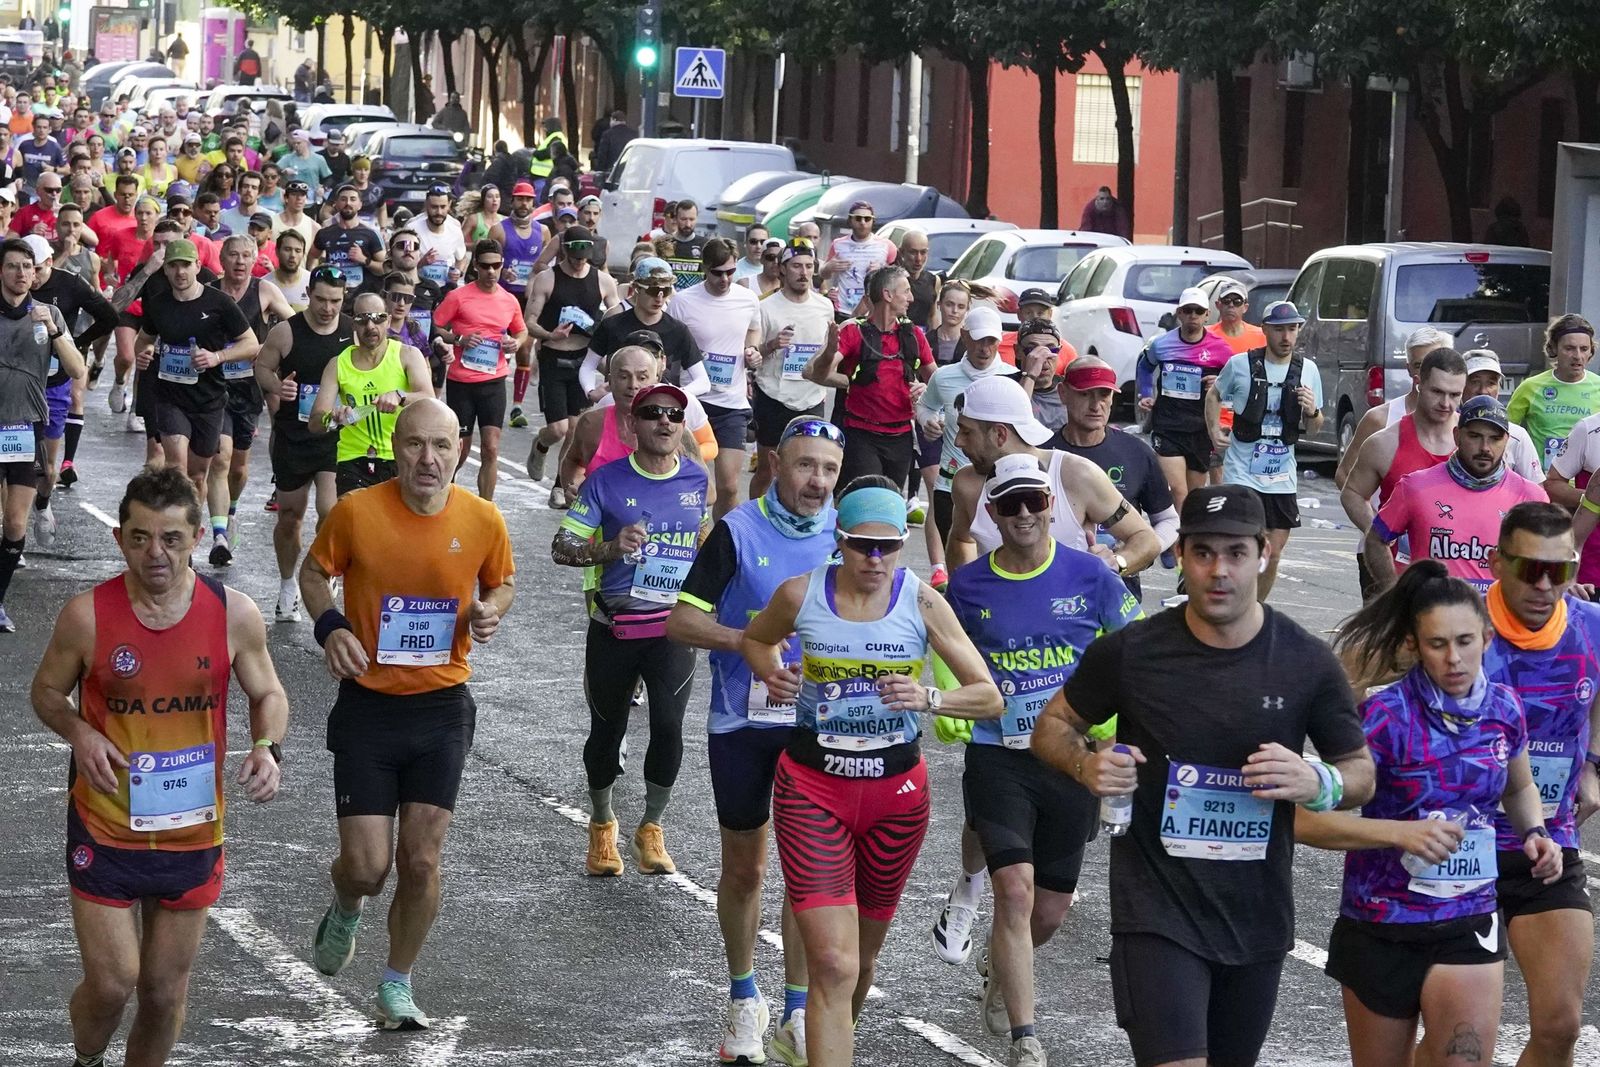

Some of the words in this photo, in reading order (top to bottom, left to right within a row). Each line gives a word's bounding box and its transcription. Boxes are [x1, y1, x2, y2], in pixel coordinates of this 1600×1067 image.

[711, 354, 733, 362] ZURICH
[166, 364, 190, 375] IRIZAR
[224, 363, 241, 371] NEIL
[784, 363, 803, 372] GREG
[1175, 365, 1196, 373] ZURICH
[1176, 383, 1186, 391] R3
[1545, 404, 1592, 416] ESTEPONA
[1, 443, 22, 452] GUIG
[647, 522, 654, 533] C
[661, 521, 669, 531] D
[675, 520, 682, 531] C
[661, 547, 693, 559] ZURICH
[661, 564, 678, 575] 7627
[408, 600, 450, 610] ZURICH
[408, 621, 430, 631] 9160
[399, 635, 435, 649] FRED
[865, 642, 905, 652] CURVA
[1025, 636, 1034, 647] D
[1043, 634, 1051, 645] C
[989, 645, 1075, 672] TUSSAM
[845, 682, 887, 694] ZURIC
[1020, 672, 1064, 691] ZURICH
[106, 697, 146, 715] CDA
[847, 704, 874, 718] 5972
[820, 716, 905, 735] MICHIGATA
[161, 750, 205, 768] ZURICH
[823, 754, 885, 778] 226ERS
[163, 777, 188, 791] 9745
[1204, 772, 1263, 788] ZURI
[1203, 800, 1236, 814] 9213
[1161, 815, 1181, 835] A.
[1188, 817, 1270, 839] FIANCES
[1437, 857, 1481, 876] FURIA
